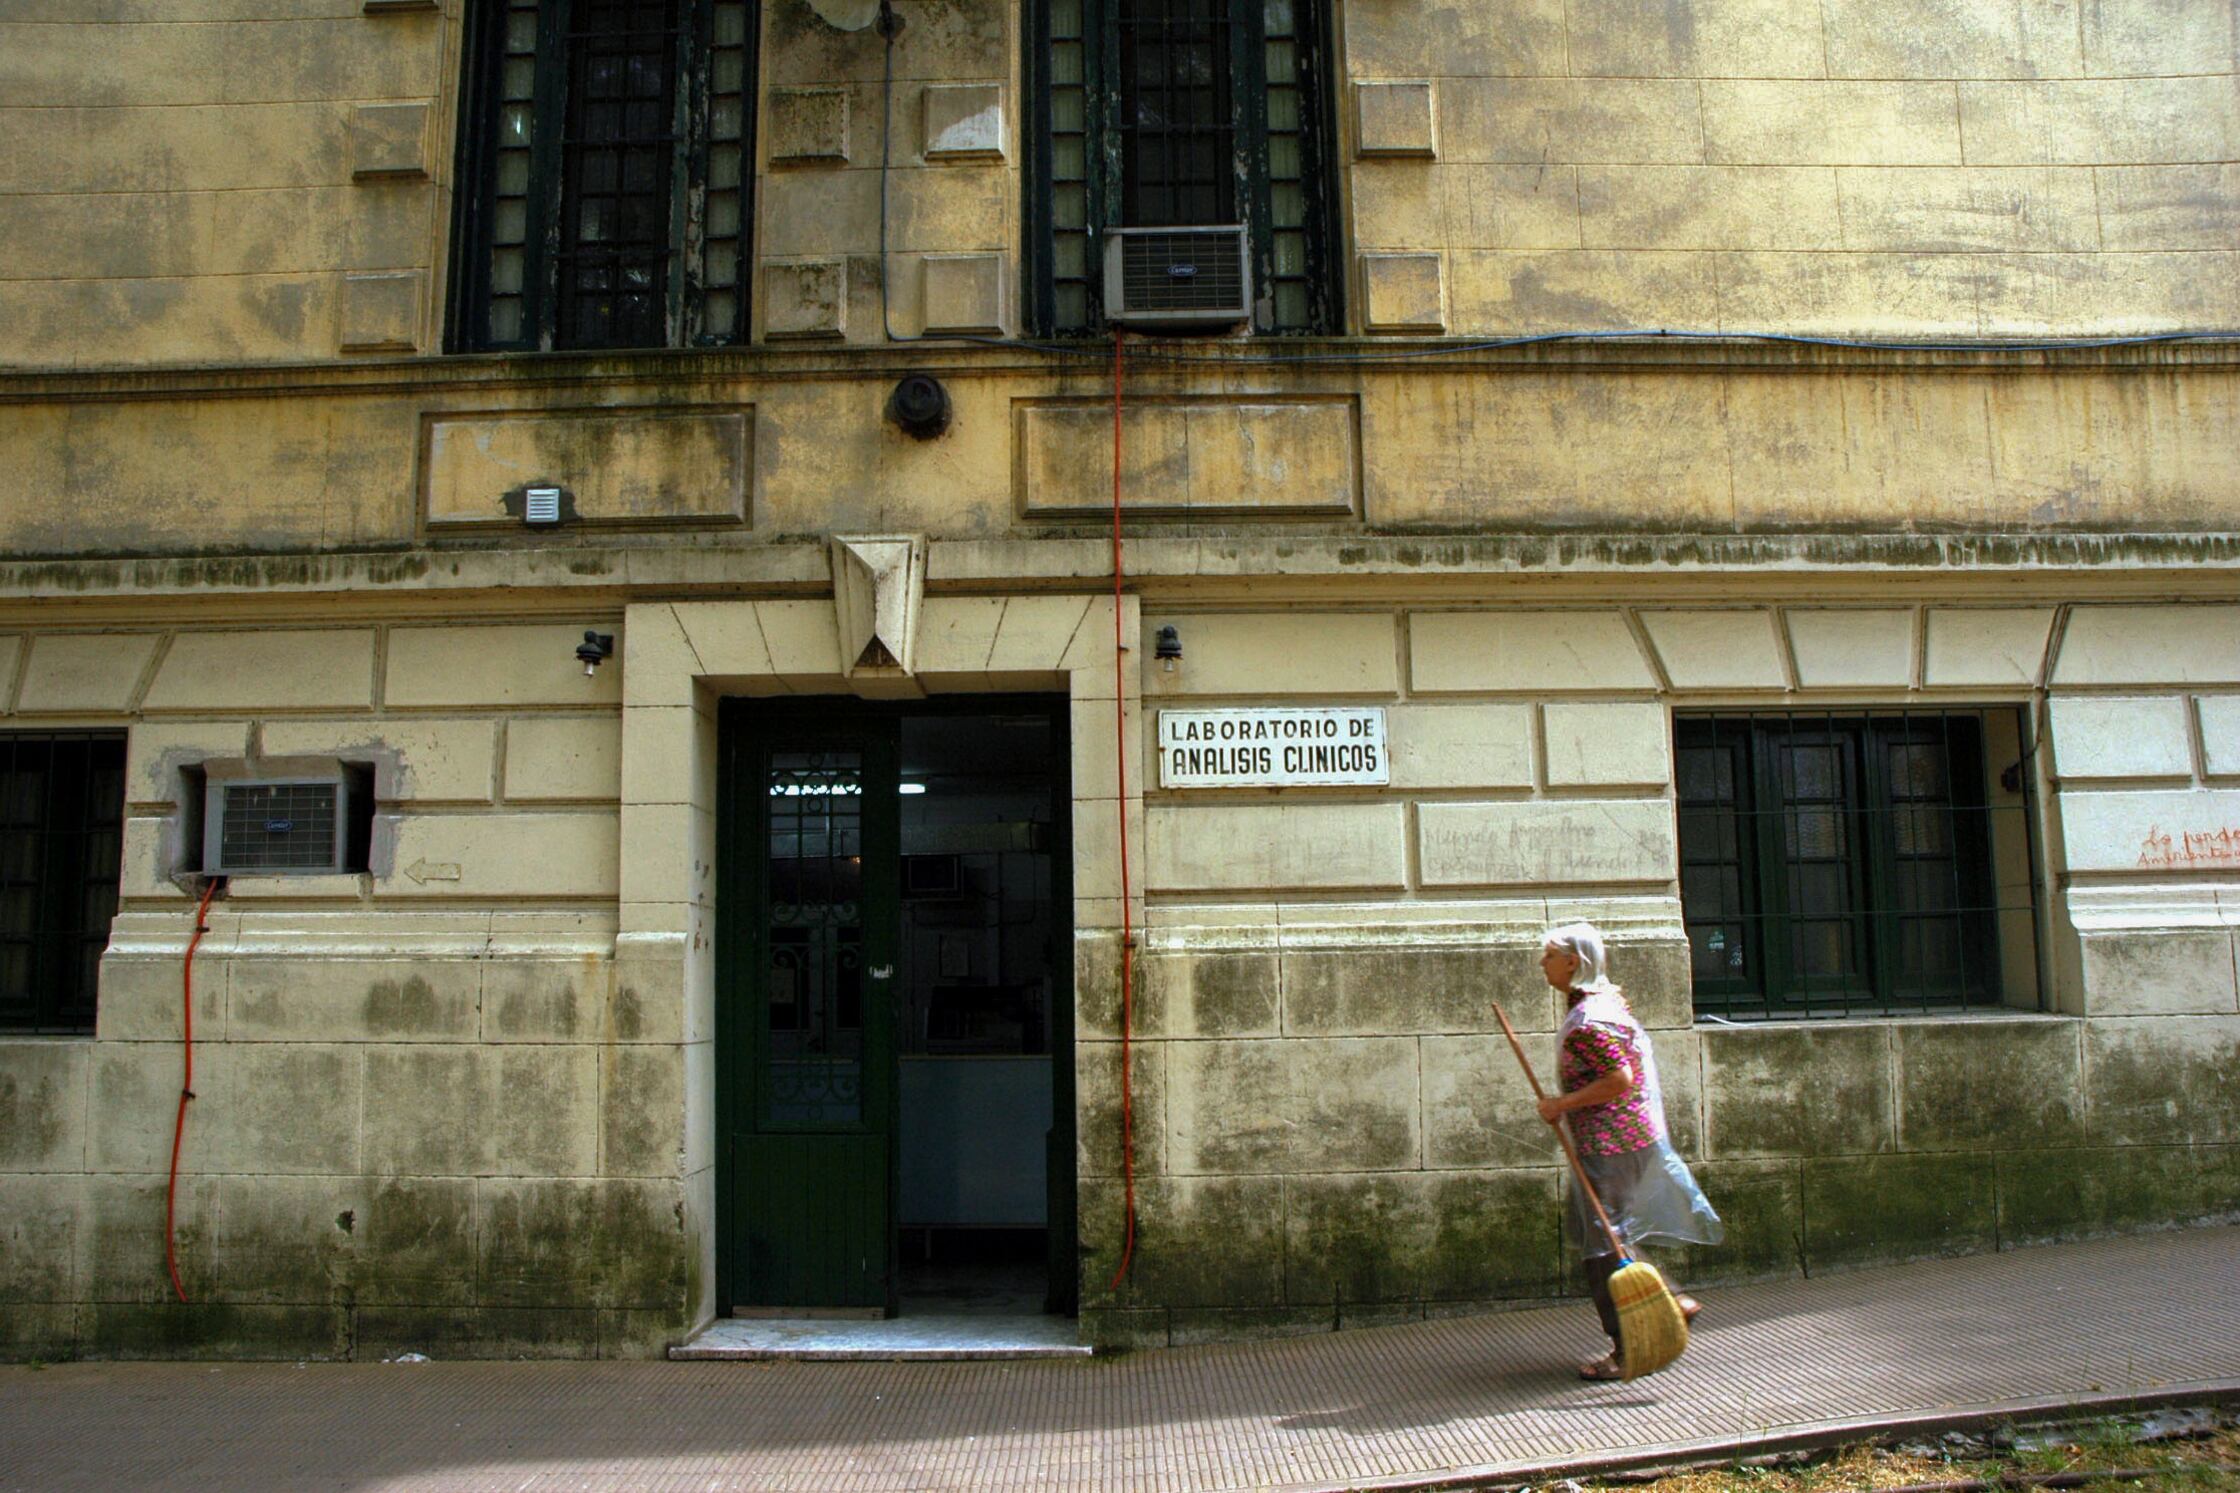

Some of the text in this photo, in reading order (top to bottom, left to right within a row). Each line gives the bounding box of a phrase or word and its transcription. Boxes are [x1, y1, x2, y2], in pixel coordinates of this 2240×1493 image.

[1171, 718, 1374, 741] LABORATORIO DE
[1173, 744, 1377, 775] ANALISIS CLINICOS
